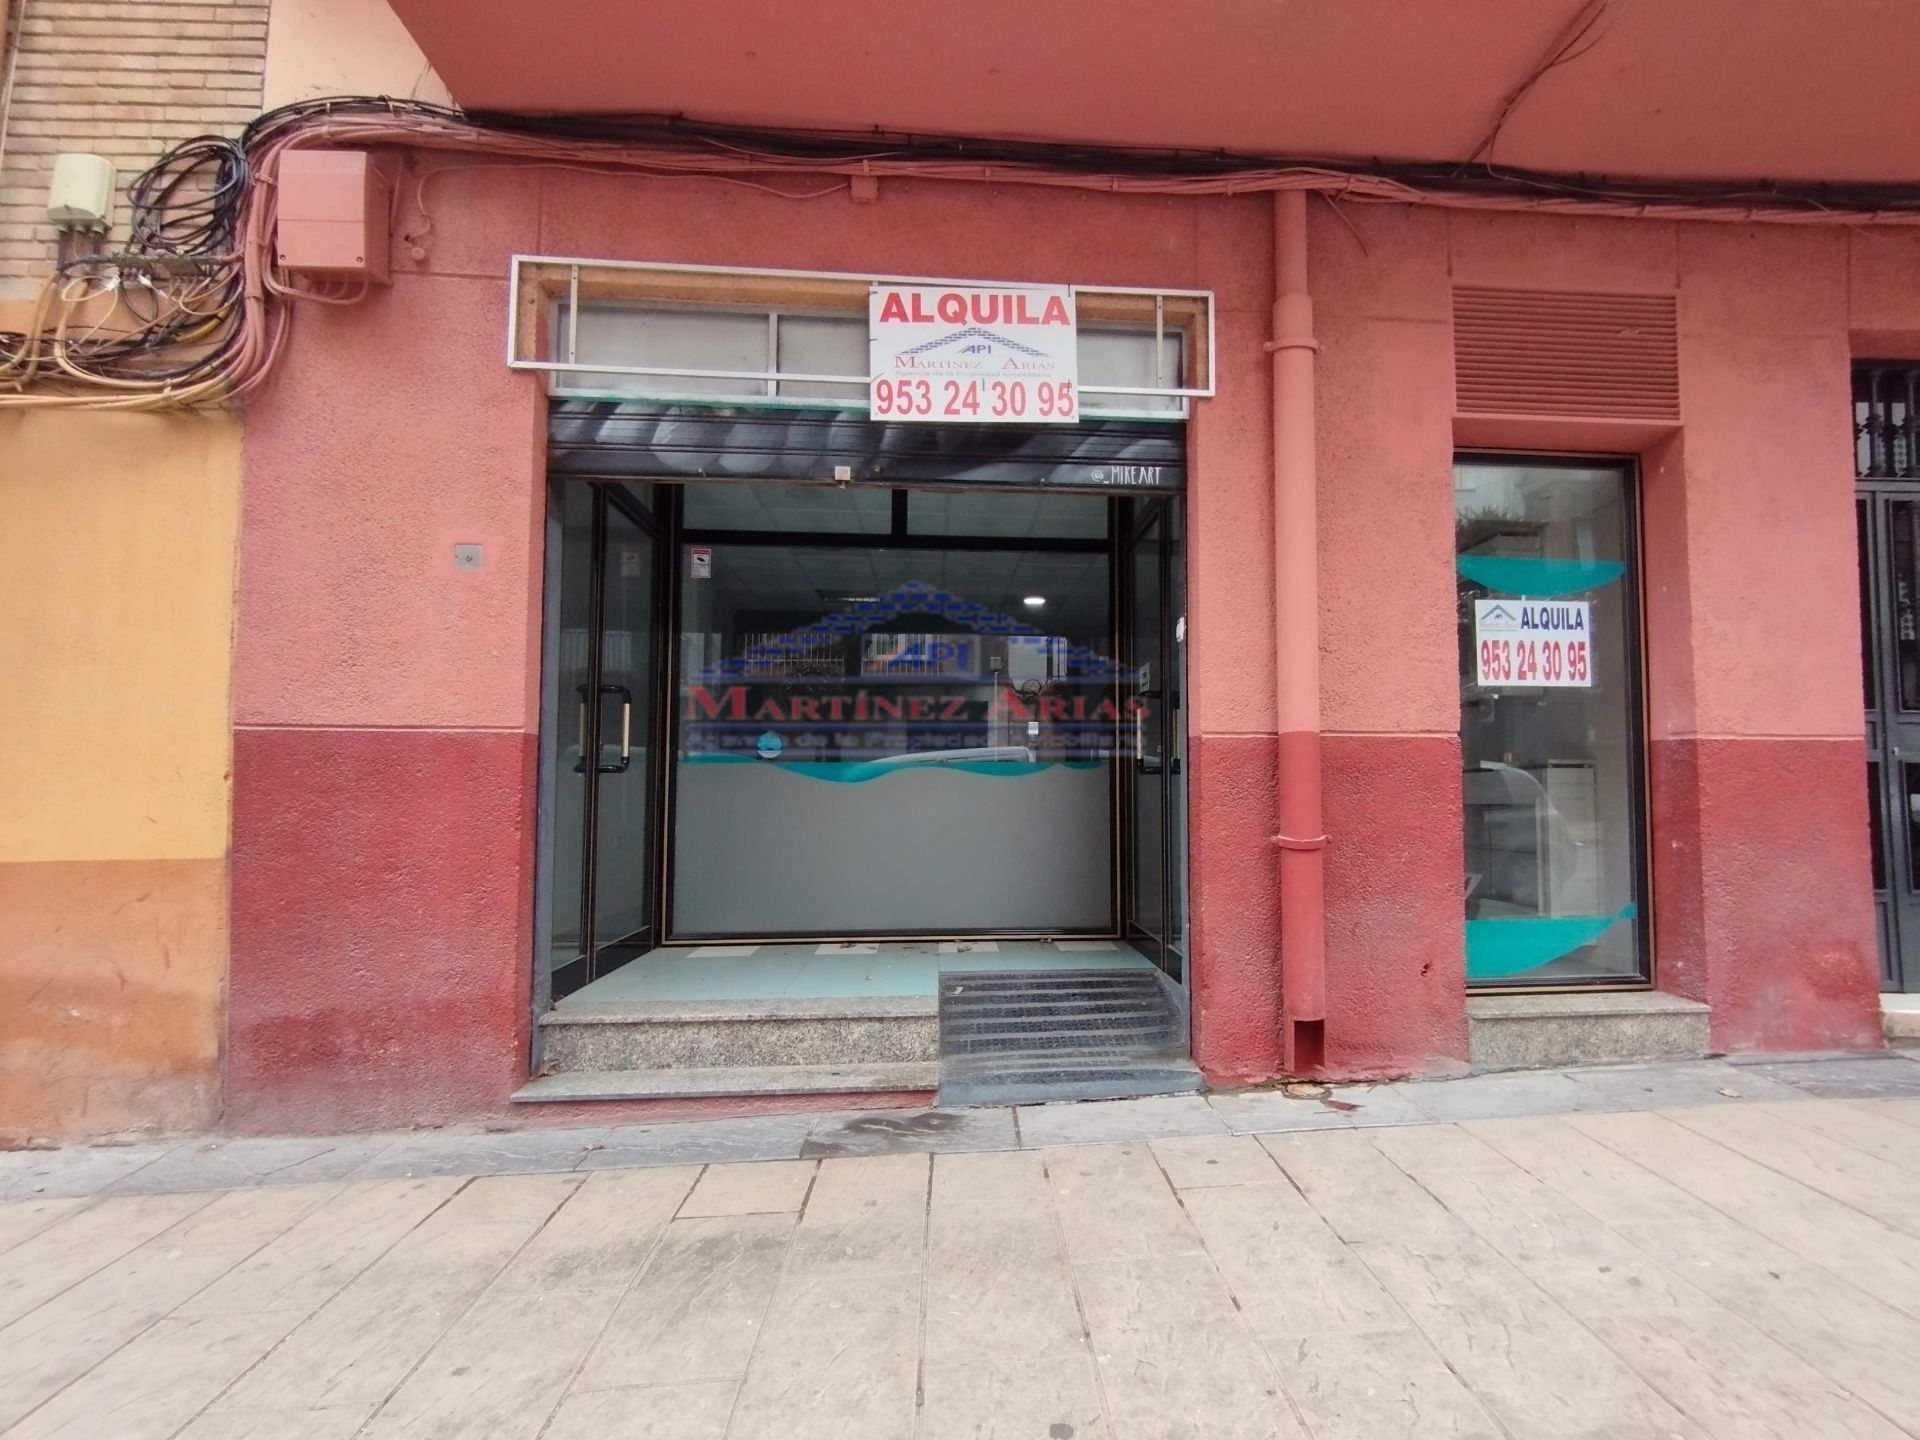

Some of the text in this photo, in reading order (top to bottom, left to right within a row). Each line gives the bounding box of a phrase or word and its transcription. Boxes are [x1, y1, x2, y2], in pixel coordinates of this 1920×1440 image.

[879, 292, 1071, 326] ALQUILA
[958, 344, 992, 355] API
[1002, 357, 1056, 370] ARIAS
[876, 379, 1074, 417] 953 24 30 95
[1520, 606, 1584, 630] ALQUILA
[1481, 639, 1587, 681] 953 24 30 95
